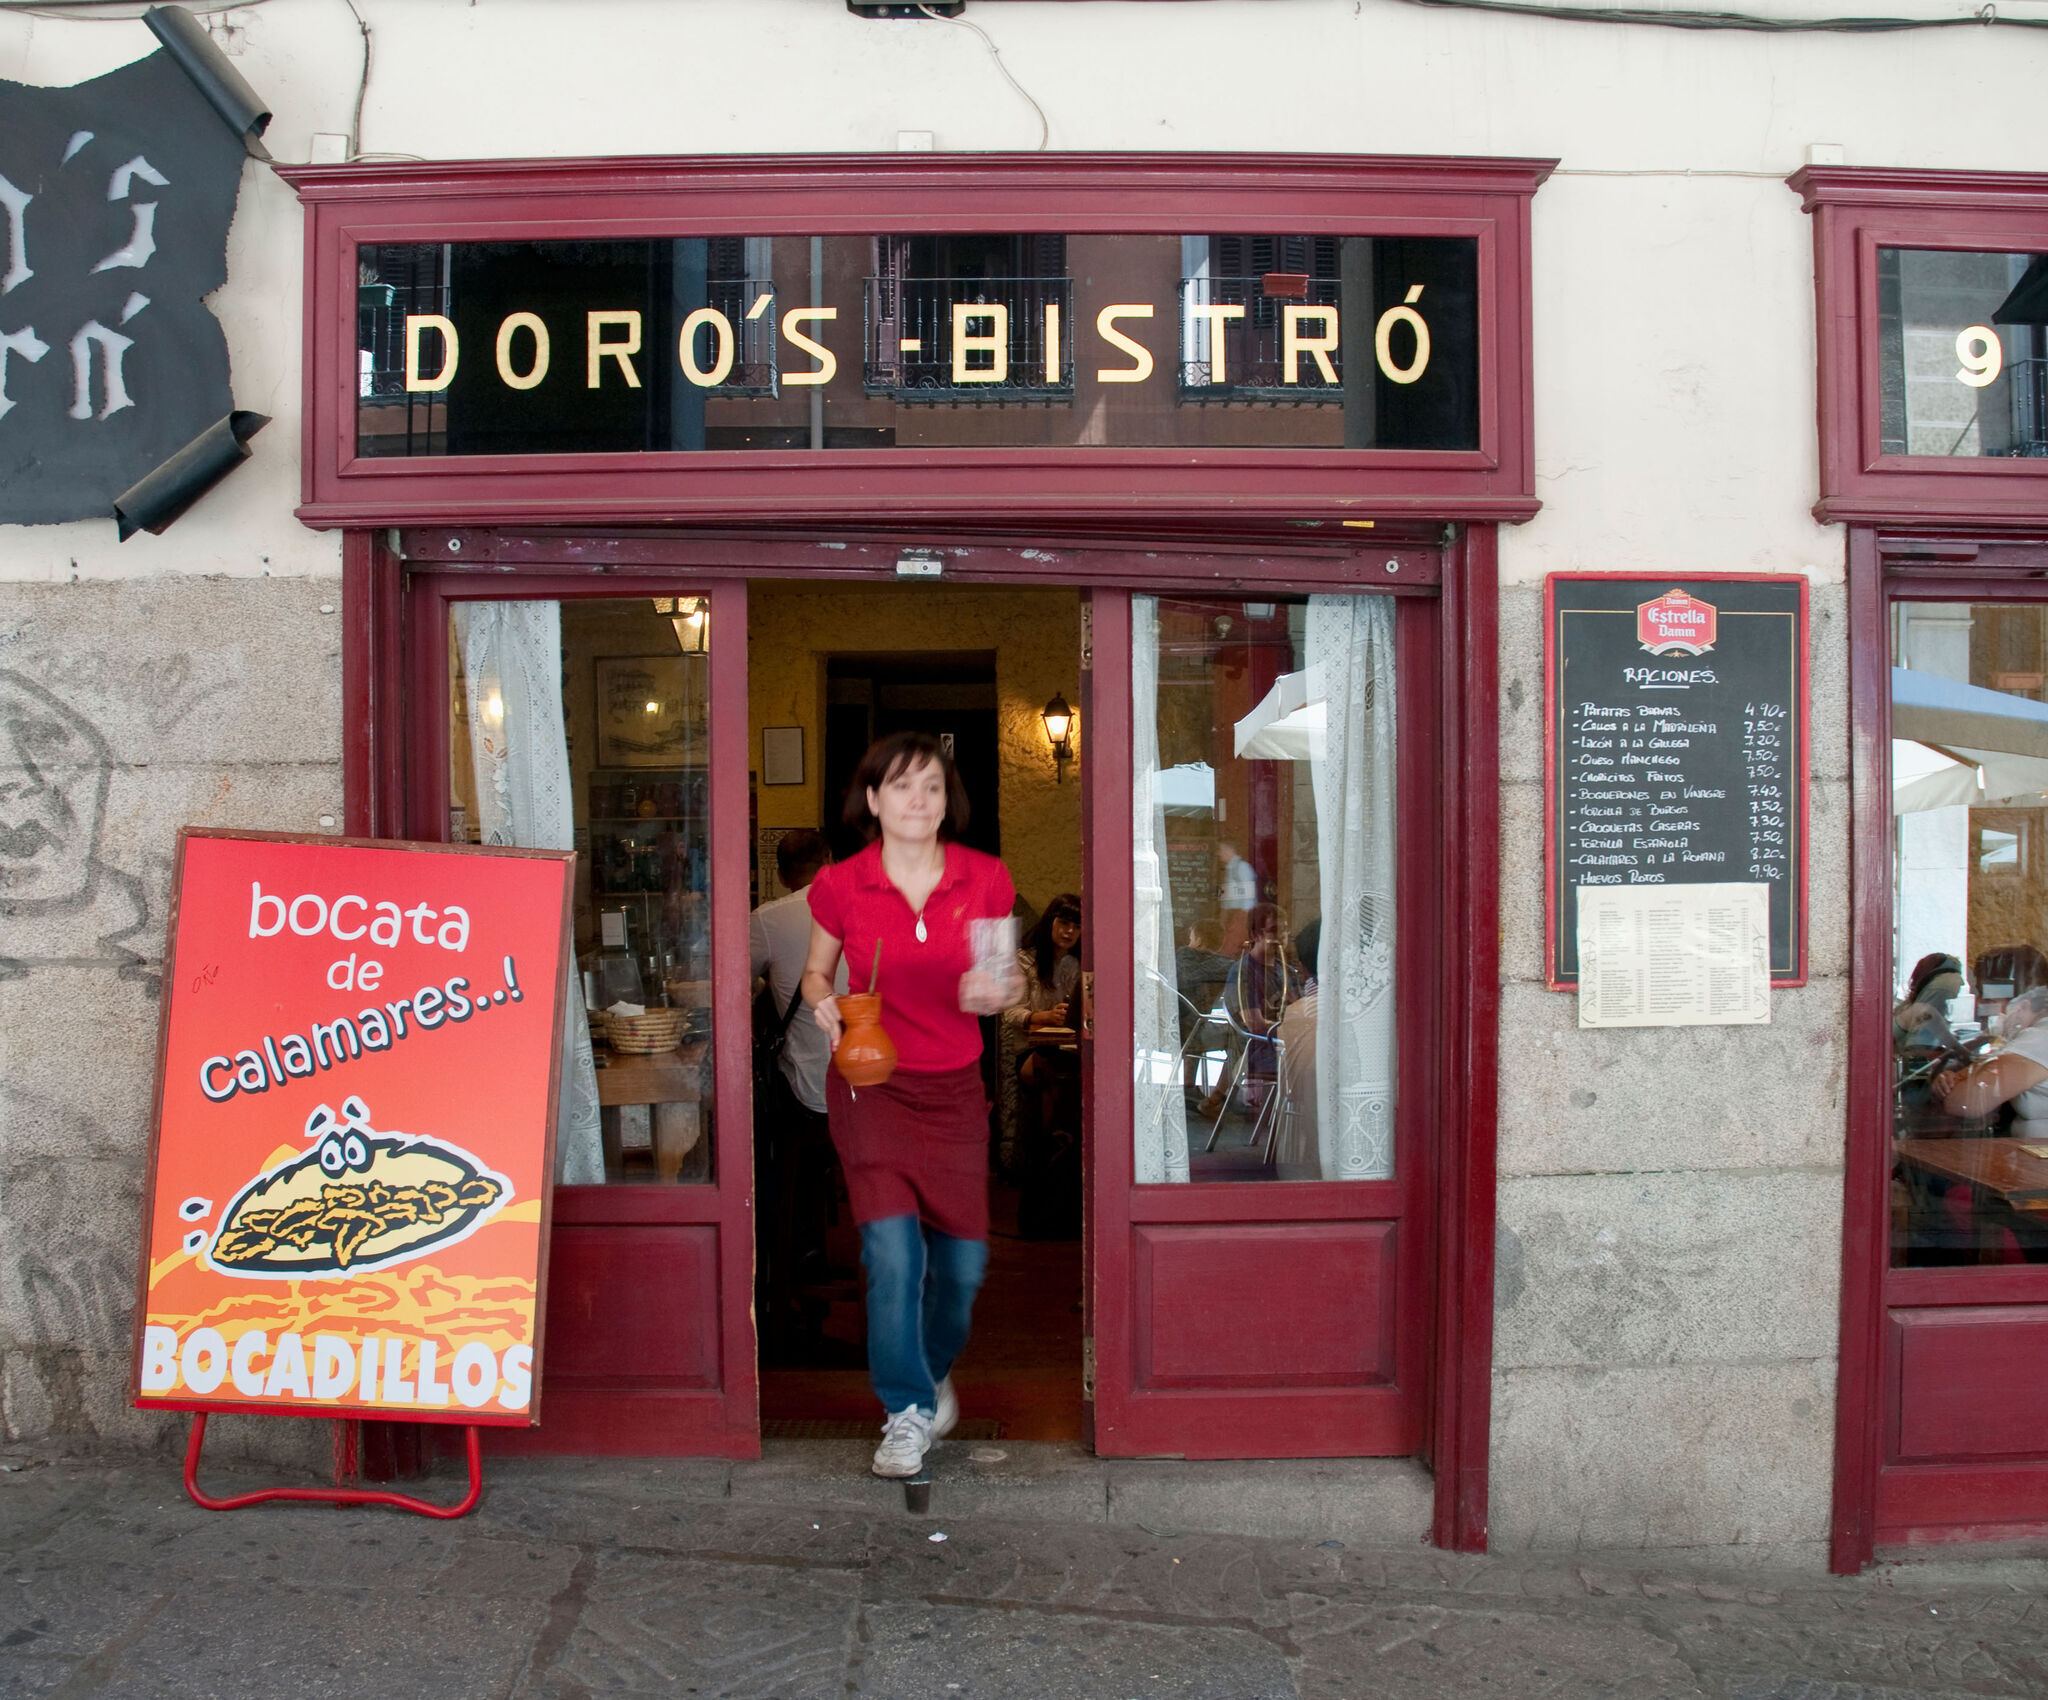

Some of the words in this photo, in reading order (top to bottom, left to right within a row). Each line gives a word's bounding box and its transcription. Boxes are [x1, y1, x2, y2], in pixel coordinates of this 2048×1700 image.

[1955, 325, 2003, 388] 9
[1648, 607, 1706, 624] Estrella
[1658, 624, 1697, 637] Damm
[1581, 702, 1631, 717] PATATAS
[1581, 719, 1617, 732] CALLOS
[1622, 721, 1629, 732] A
[1634, 721, 1646, 732] LA
[1620, 737, 1628, 748] A
[1632, 738, 1643, 748] LA
[1649, 737, 1690, 749] GALLEGA
[1580, 753, 1614, 766] QUESO
[1660, 791, 1677, 800] EN
[1683, 785, 1727, 800] VINAGRE
[1629, 807, 1642, 816] DE
[1647, 803, 1689, 816] BURGOS
[1578, 820, 1643, 833] CROQUETAS
[1650, 820, 1701, 832] CASERAS
[1647, 854, 1656, 865] A
[1663, 852, 1675, 864] LA
[1682, 850, 1726, 863] ROMANA
[1580, 871, 1622, 885] HUEVOS
[1628, 869, 1666, 884] ROTOS
[248, 881, 471, 952] bocata
[326, 953, 384, 991] de
[141, 1326, 534, 1410] BOCADILLOS
